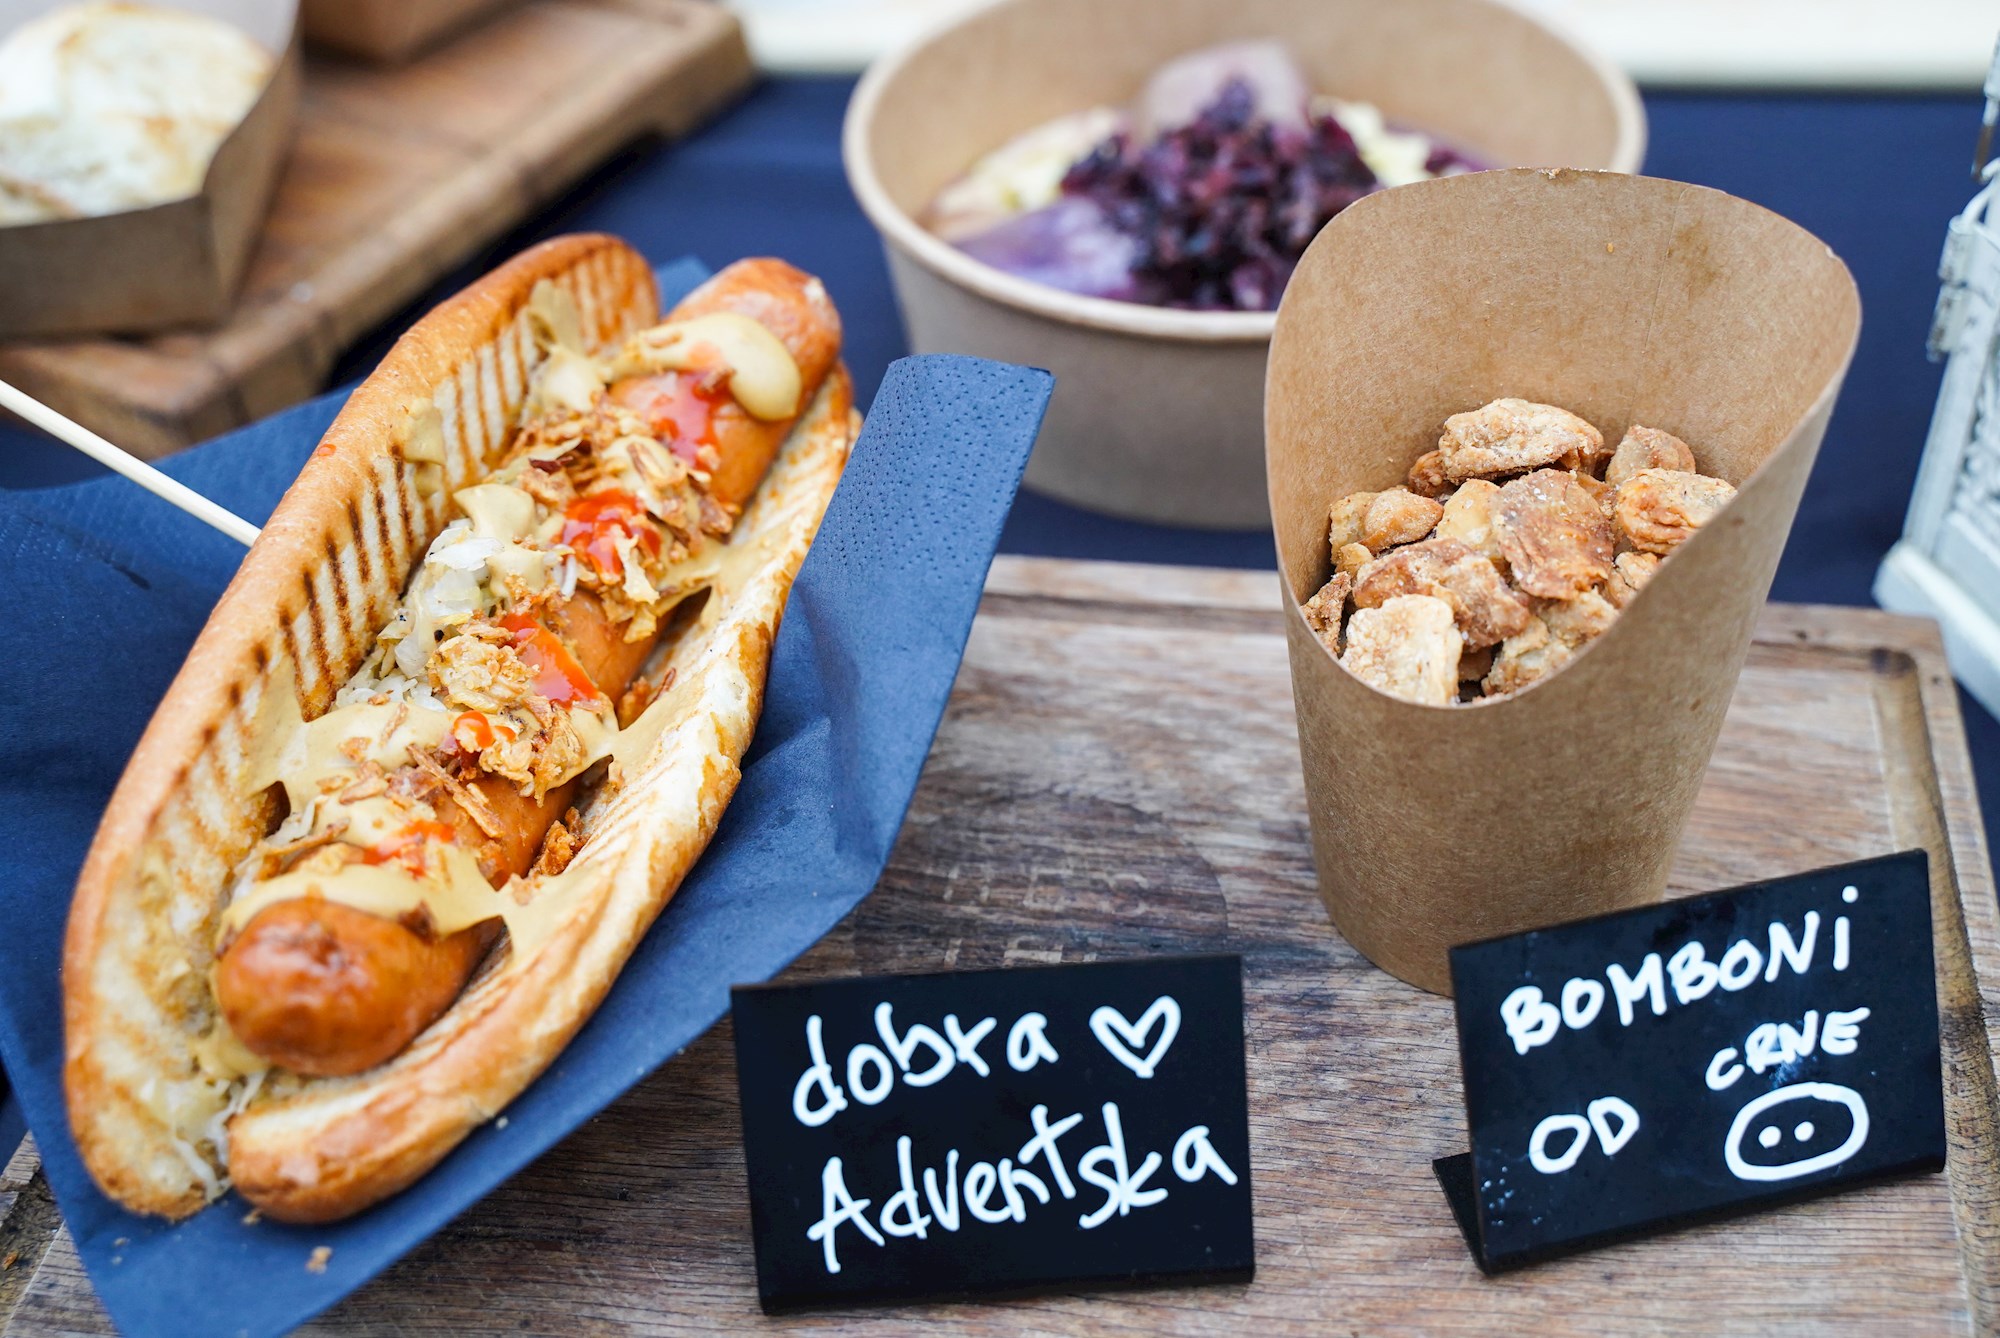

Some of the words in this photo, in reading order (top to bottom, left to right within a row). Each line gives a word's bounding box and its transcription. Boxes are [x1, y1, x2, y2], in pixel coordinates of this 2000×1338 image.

[793, 1002, 1058, 1126] dobra
[1529, 1096, 1640, 1174] OD
[1705, 1007, 1871, 1090] CRNE
[807, 1102, 1238, 1273] Adventska
